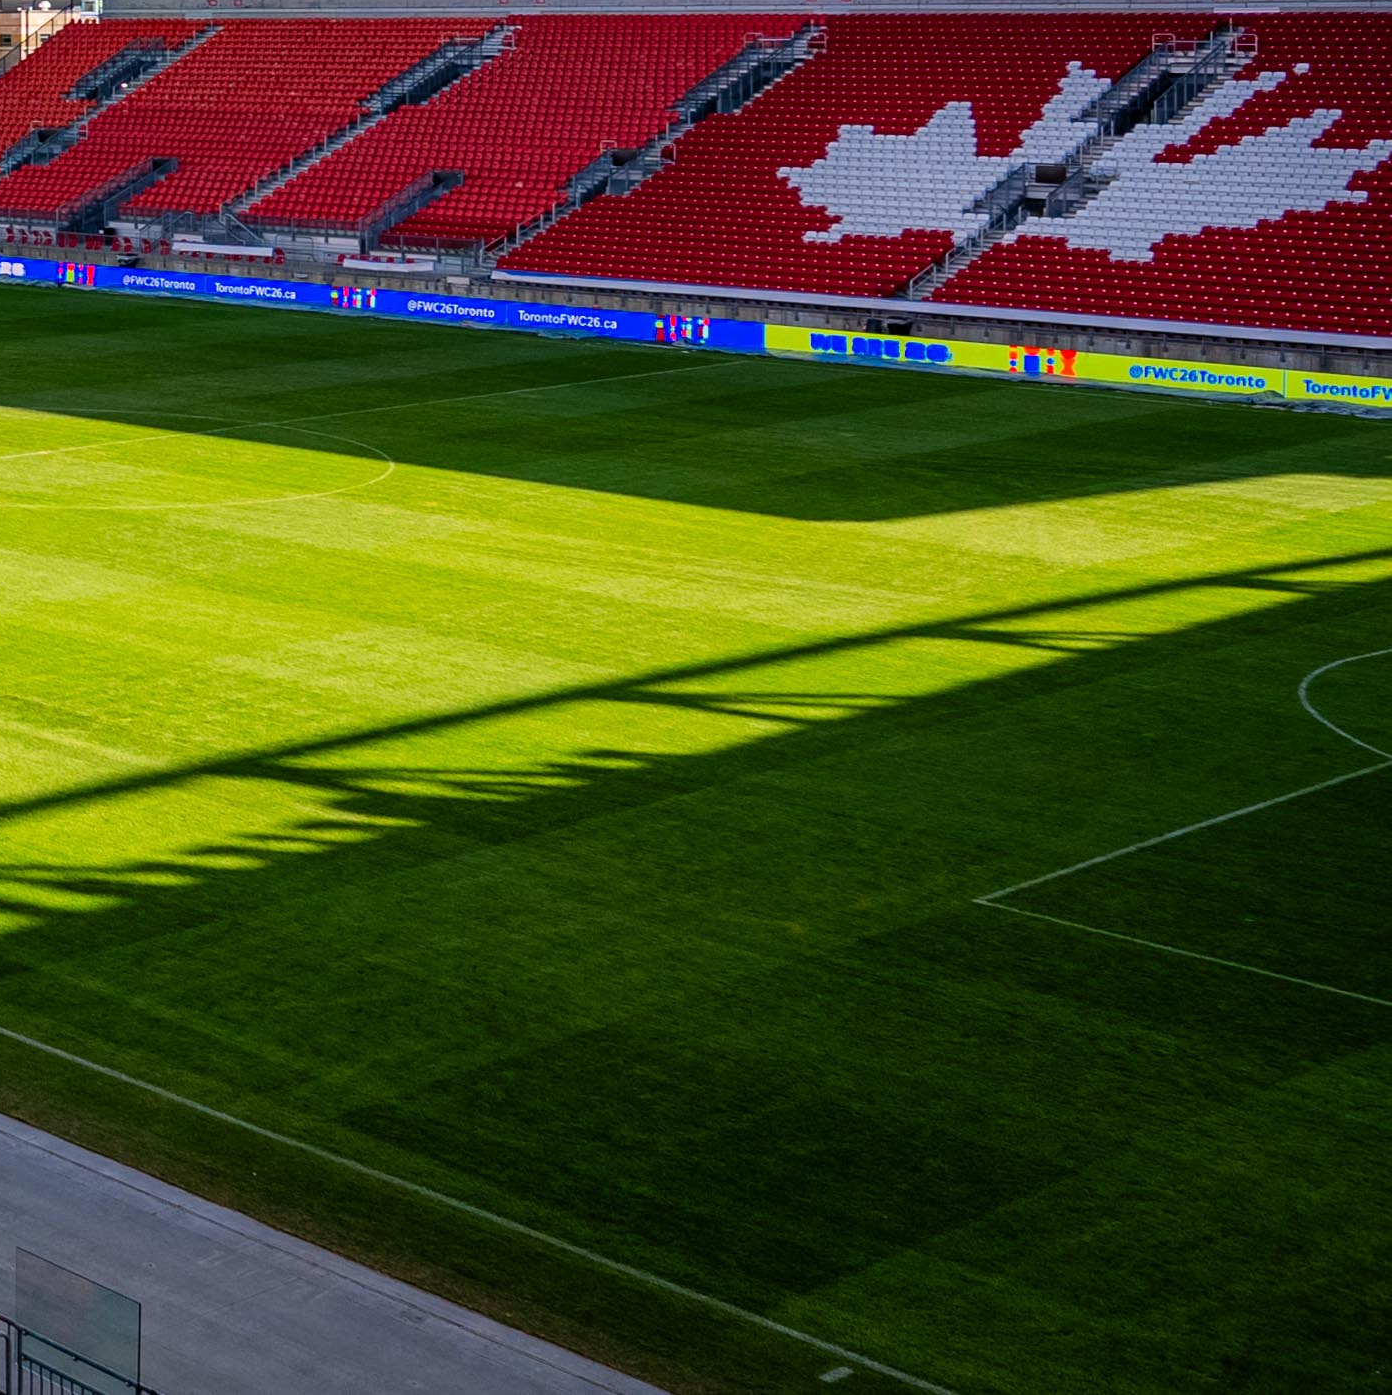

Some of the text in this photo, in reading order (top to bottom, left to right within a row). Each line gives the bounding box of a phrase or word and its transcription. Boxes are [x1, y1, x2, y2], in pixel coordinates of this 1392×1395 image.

[123, 274, 196, 291] @FWC26Toronto
[215, 282, 297, 300] TorontoFWC26.ca
[407, 299, 495, 319] @FWC26Toronto
[518, 309, 618, 330] TorontoFWC26.ca
[1129, 364, 1266, 389] @FWC26Toronto
